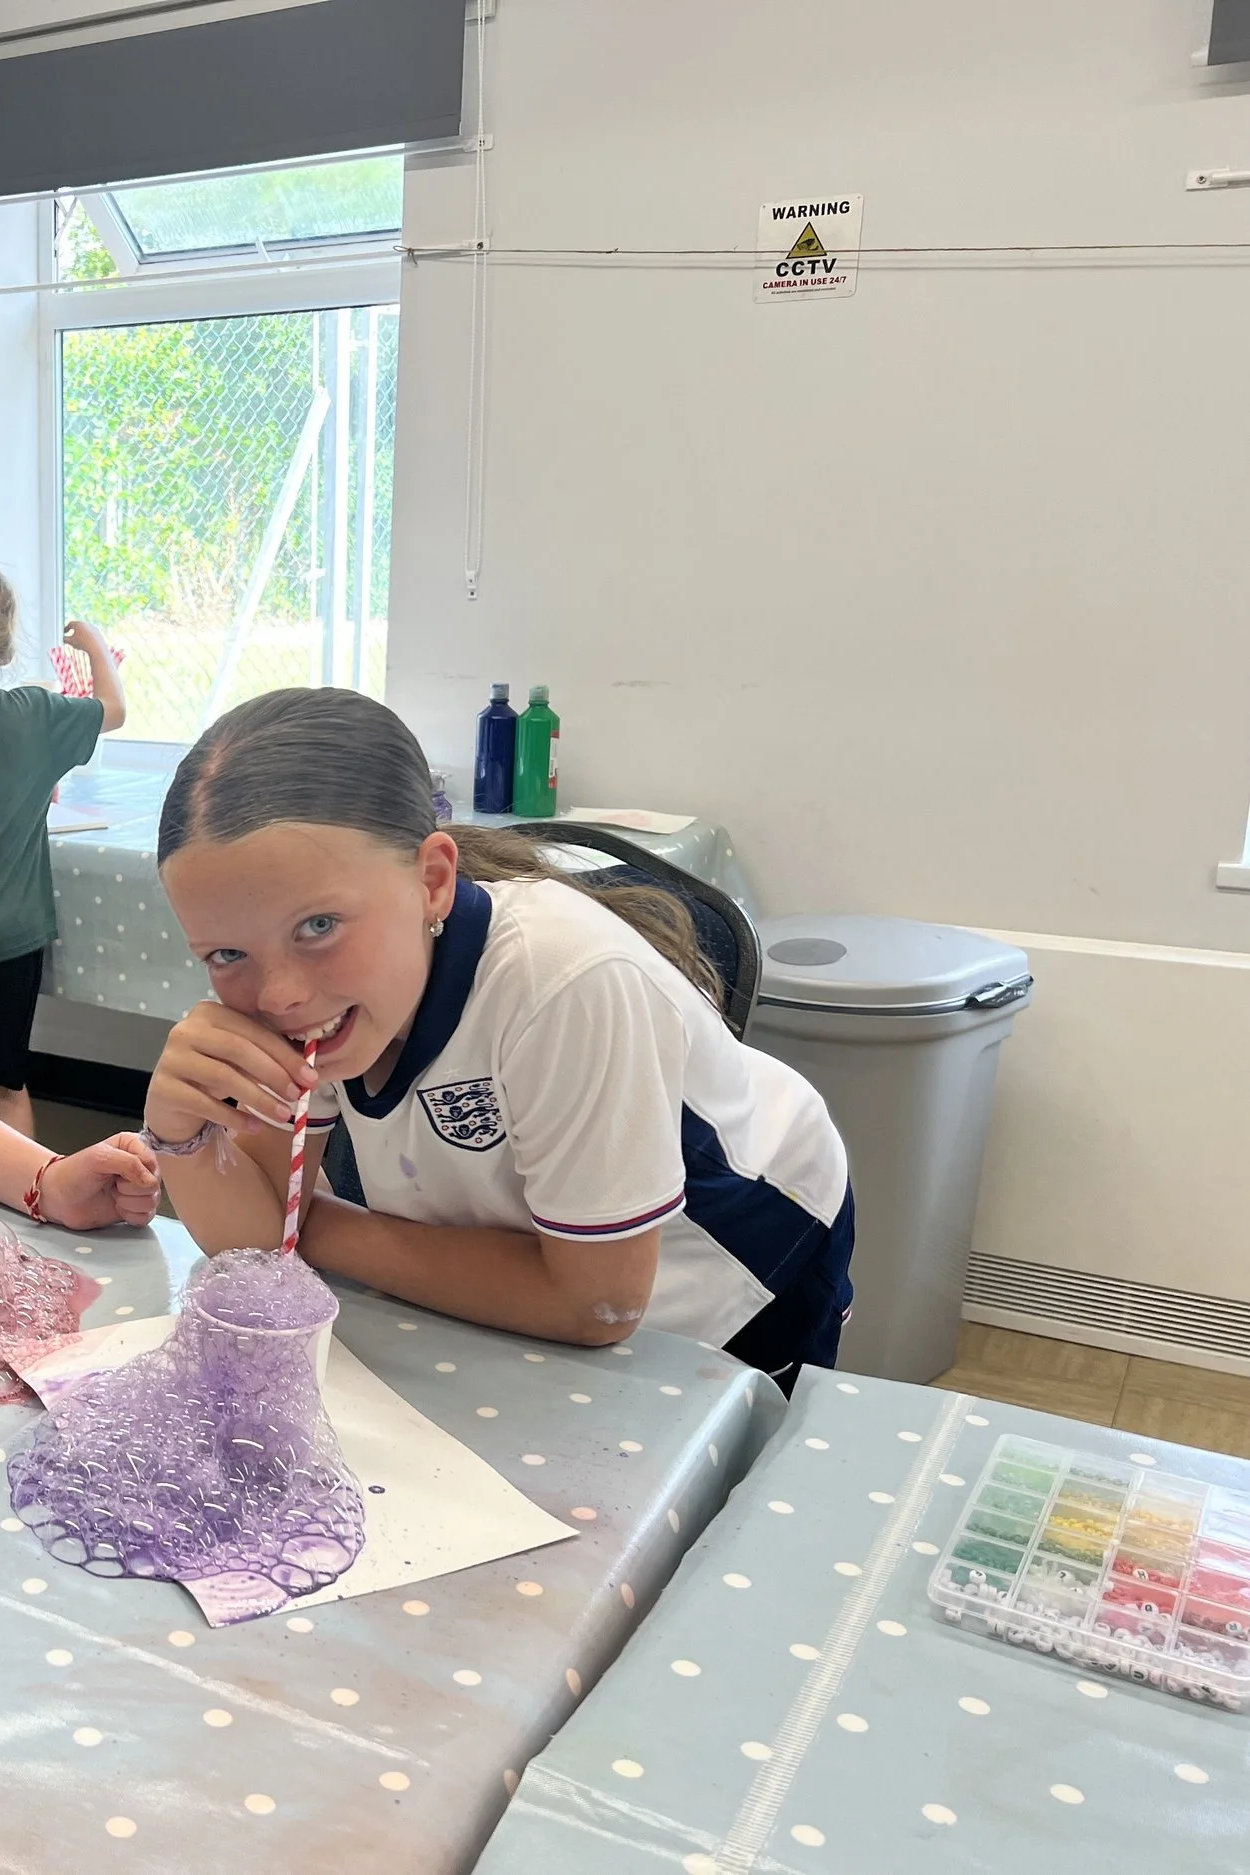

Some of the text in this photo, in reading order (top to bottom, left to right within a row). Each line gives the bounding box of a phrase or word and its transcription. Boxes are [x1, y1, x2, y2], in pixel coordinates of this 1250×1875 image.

[772, 201, 850, 220] WARNING
[776, 258, 837, 277] CCTV
[763, 280, 797, 289] CAMERA
[829, 276, 847, 284] 24/7
